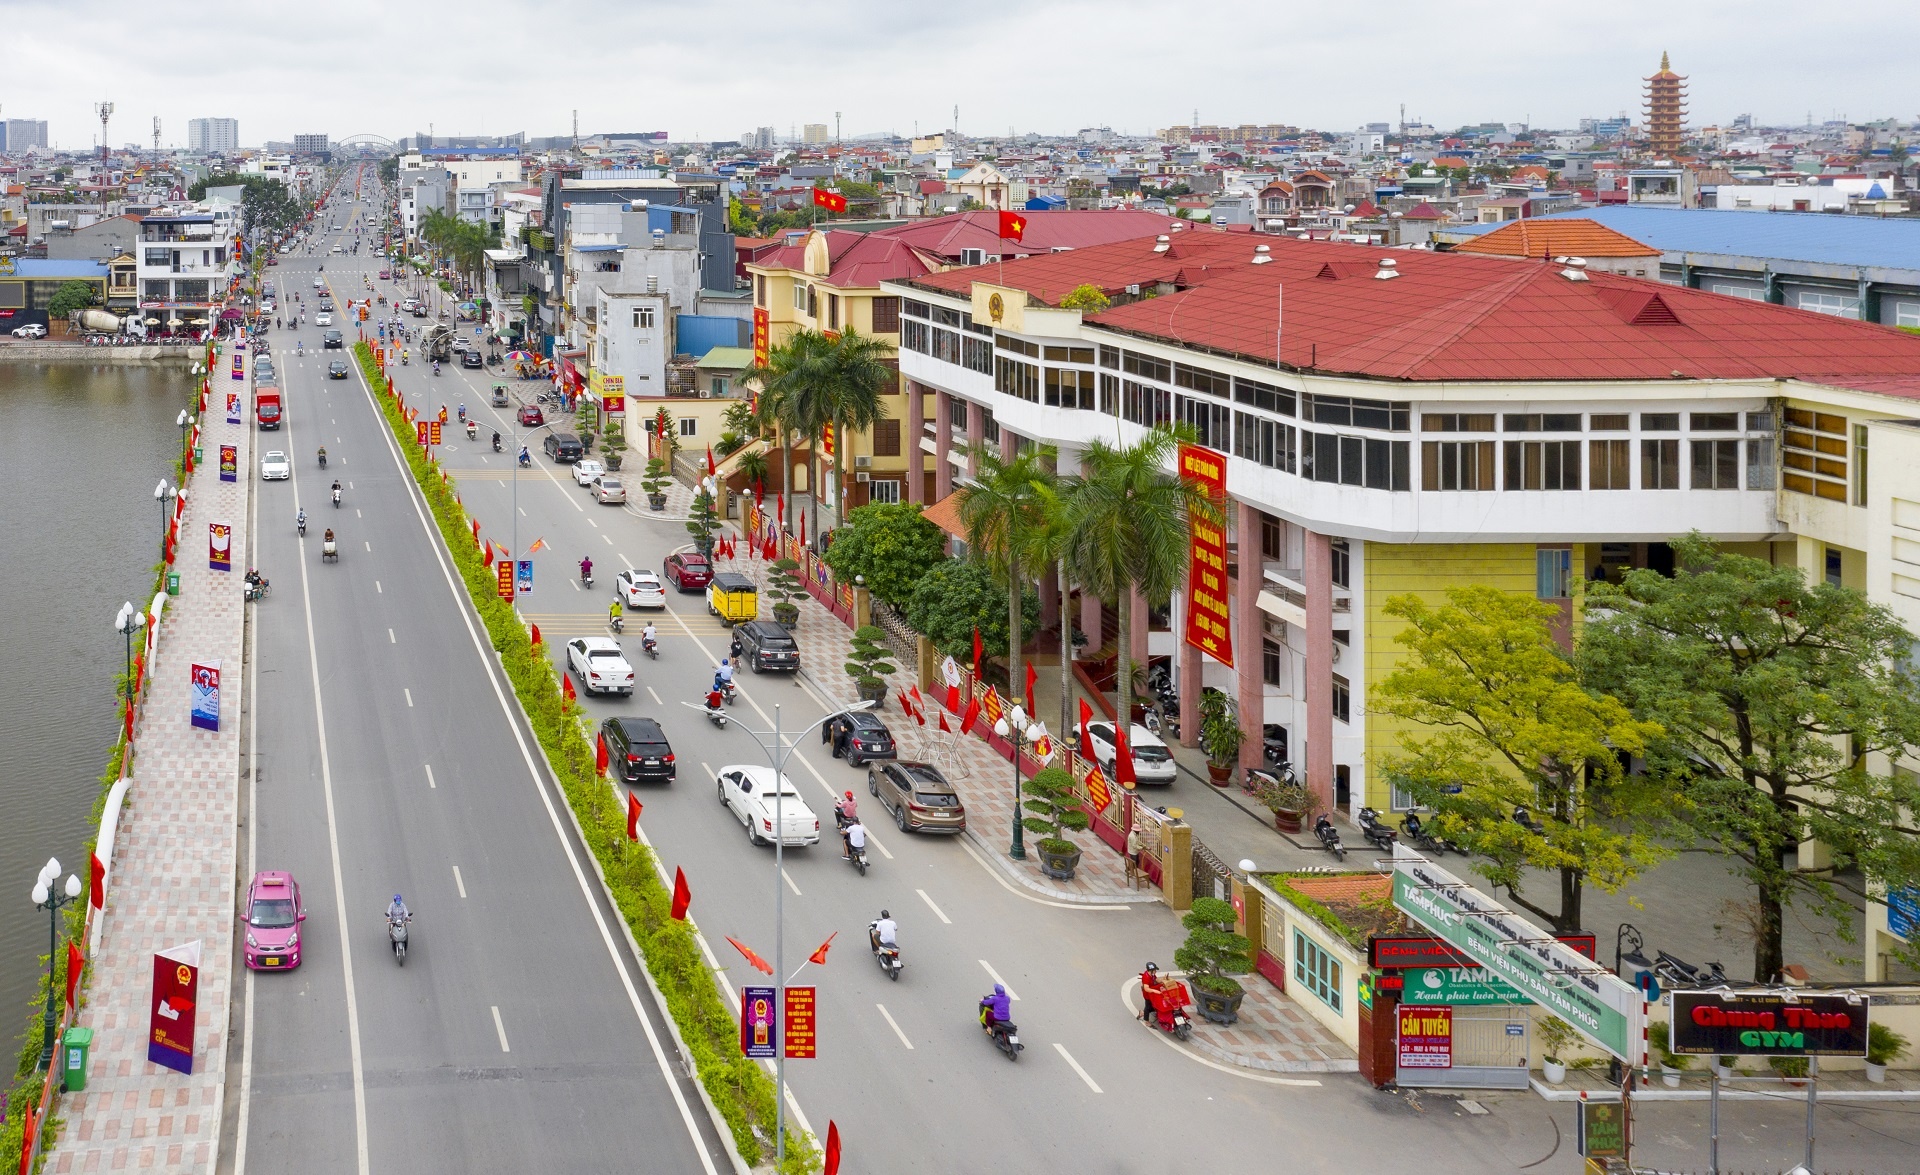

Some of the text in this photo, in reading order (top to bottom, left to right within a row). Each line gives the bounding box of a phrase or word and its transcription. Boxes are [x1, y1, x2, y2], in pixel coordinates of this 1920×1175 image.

[1484, 934, 1492, 942] TY
[1537, 948, 1550, 961] SỐ
[1552, 958, 1563, 970] 10
[1580, 976, 1599, 993] SEN
[1467, 936, 1599, 1030] BỆNH VIỆN PHỤ SẢN TÂM PHÚC
[1414, 990, 1443, 1001] Hạnh
[1446, 989, 1470, 1001] phúc
[1472, 991, 1494, 1000] luôn
[1402, 1012, 1449, 1036] CẦN TUYỂN
[1739, 1031, 1804, 1048] GYM
[1590, 1121, 1618, 1135] TÂM
[1588, 1135, 1621, 1149] PHÚC
